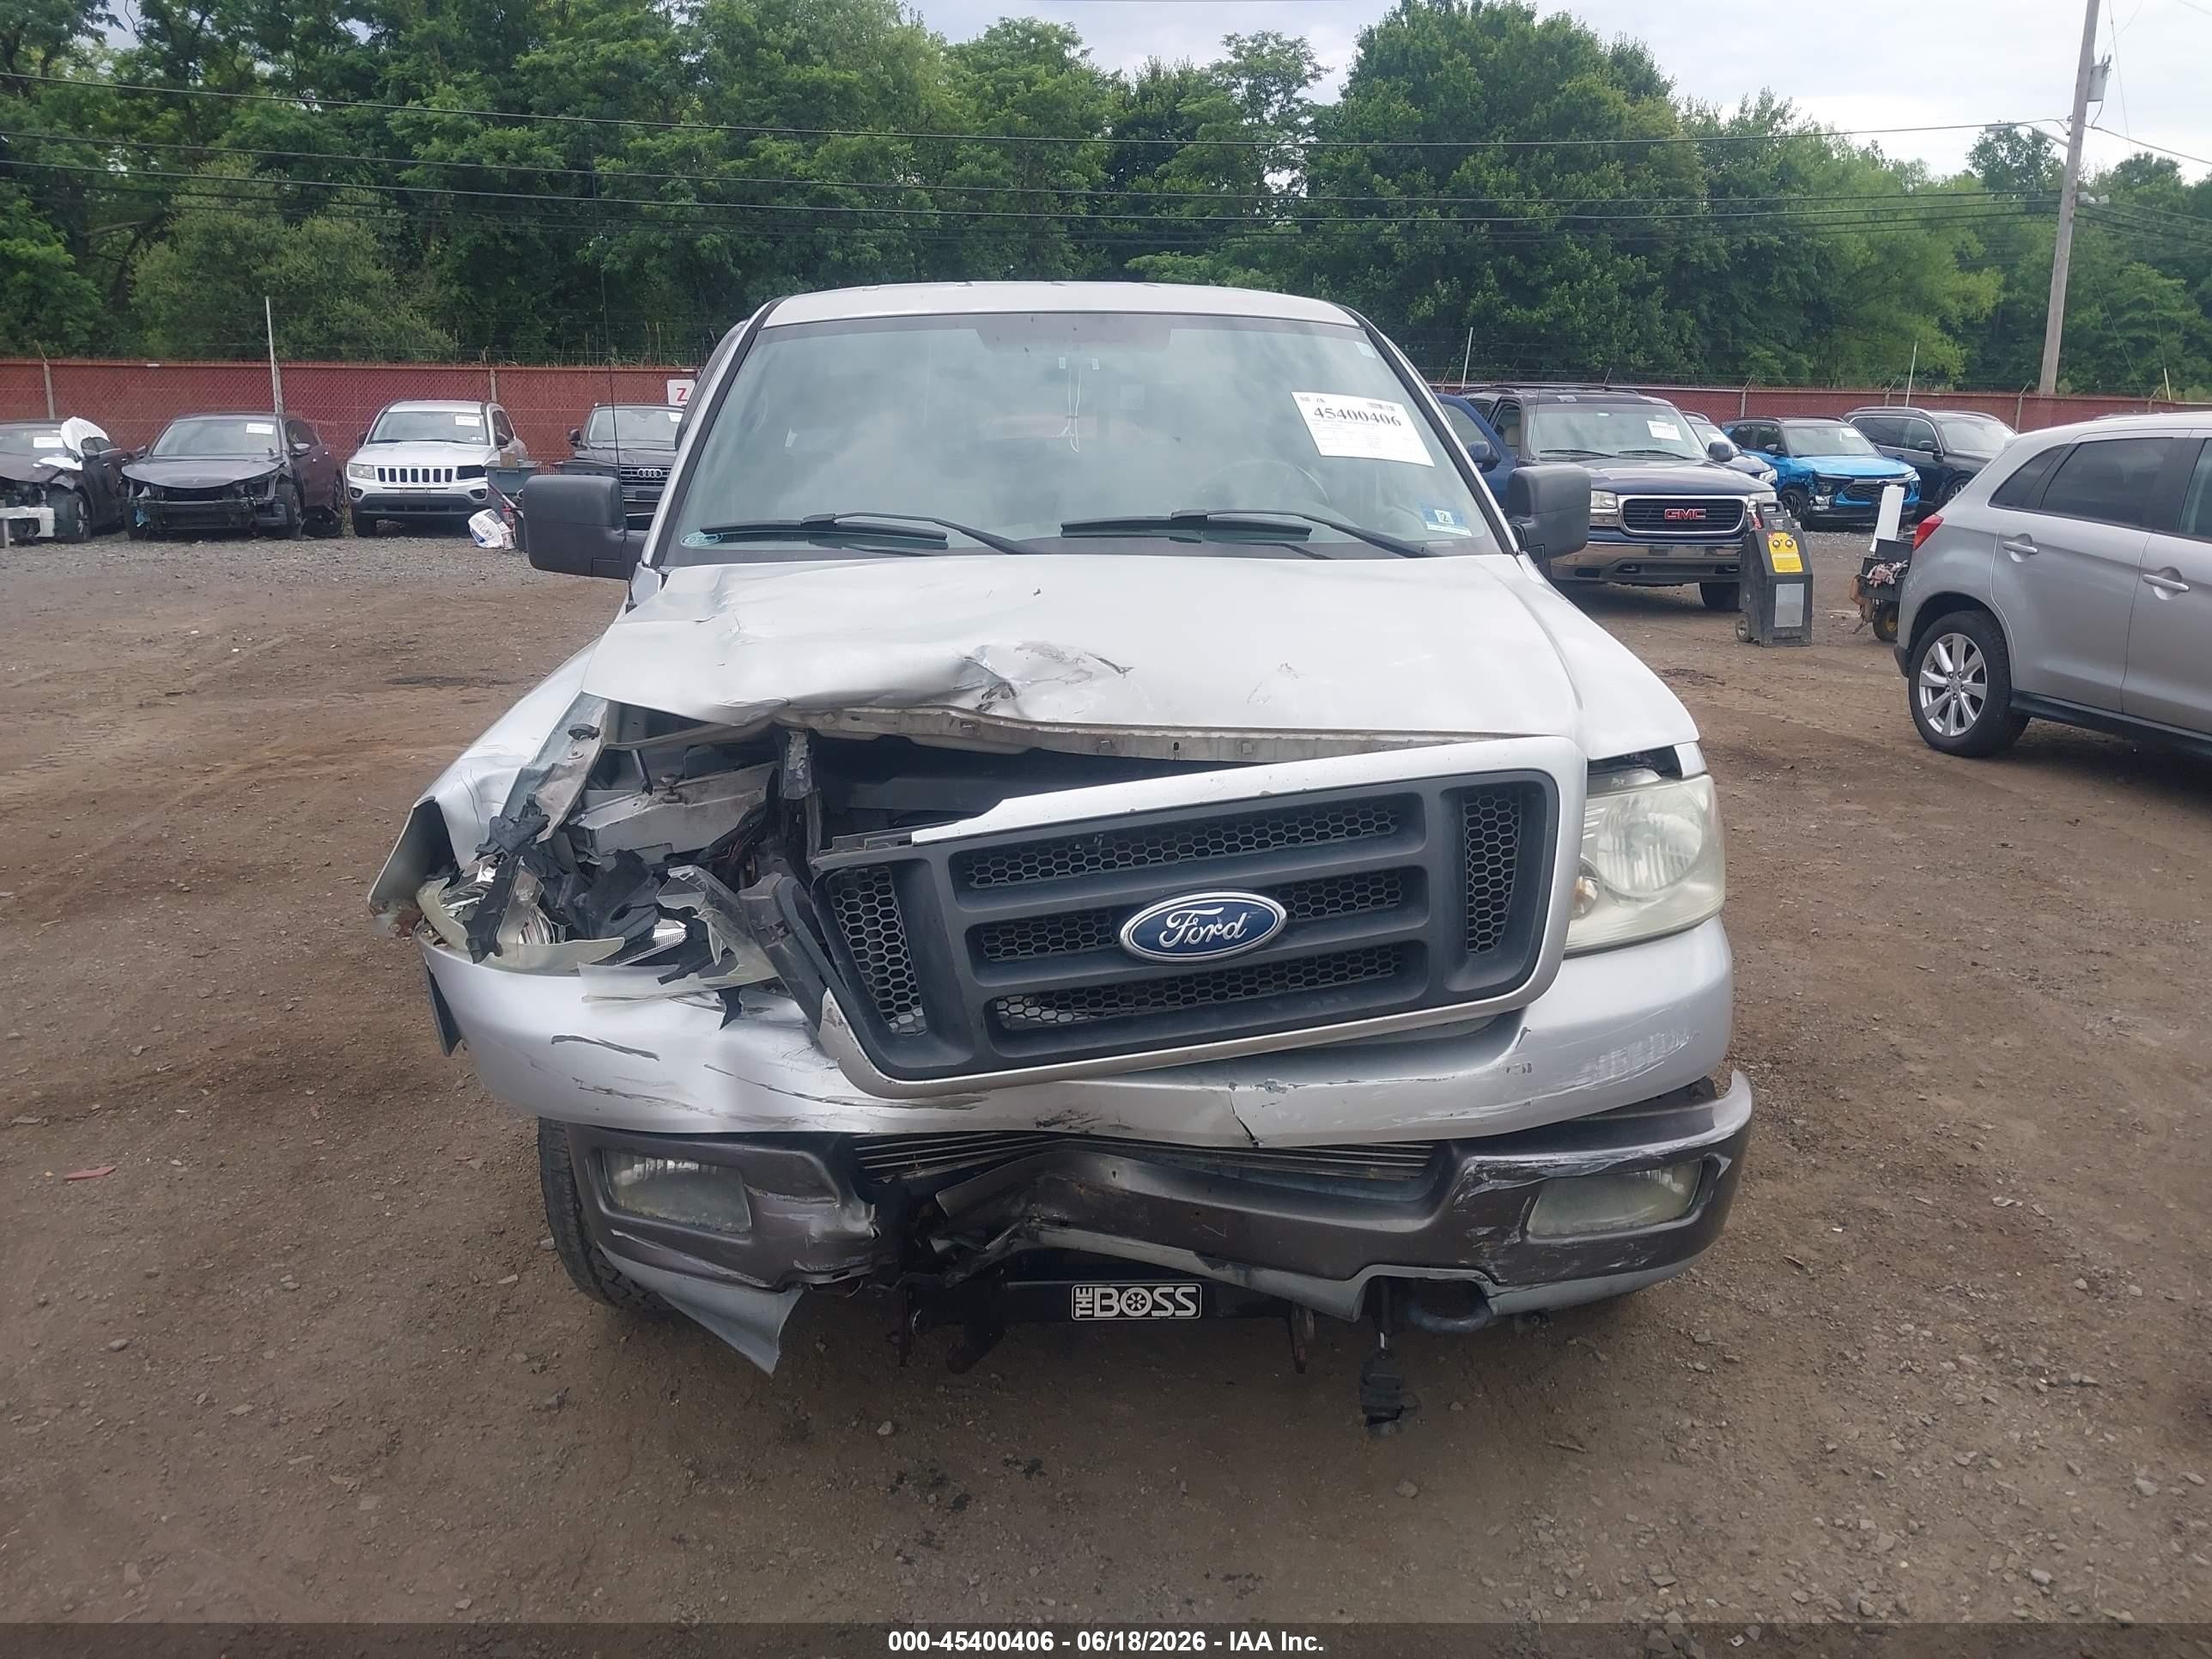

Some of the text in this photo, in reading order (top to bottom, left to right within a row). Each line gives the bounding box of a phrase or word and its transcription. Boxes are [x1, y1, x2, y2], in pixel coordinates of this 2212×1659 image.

[677, 387, 688, 402] Z
[1314, 407, 1401, 427] 45400406
[1440, 512, 1449, 523] 2
[1664, 508, 1706, 520] GMC
[1159, 907, 1248, 948] Ford
[1075, 1286, 1197, 1318] THE BOSS
